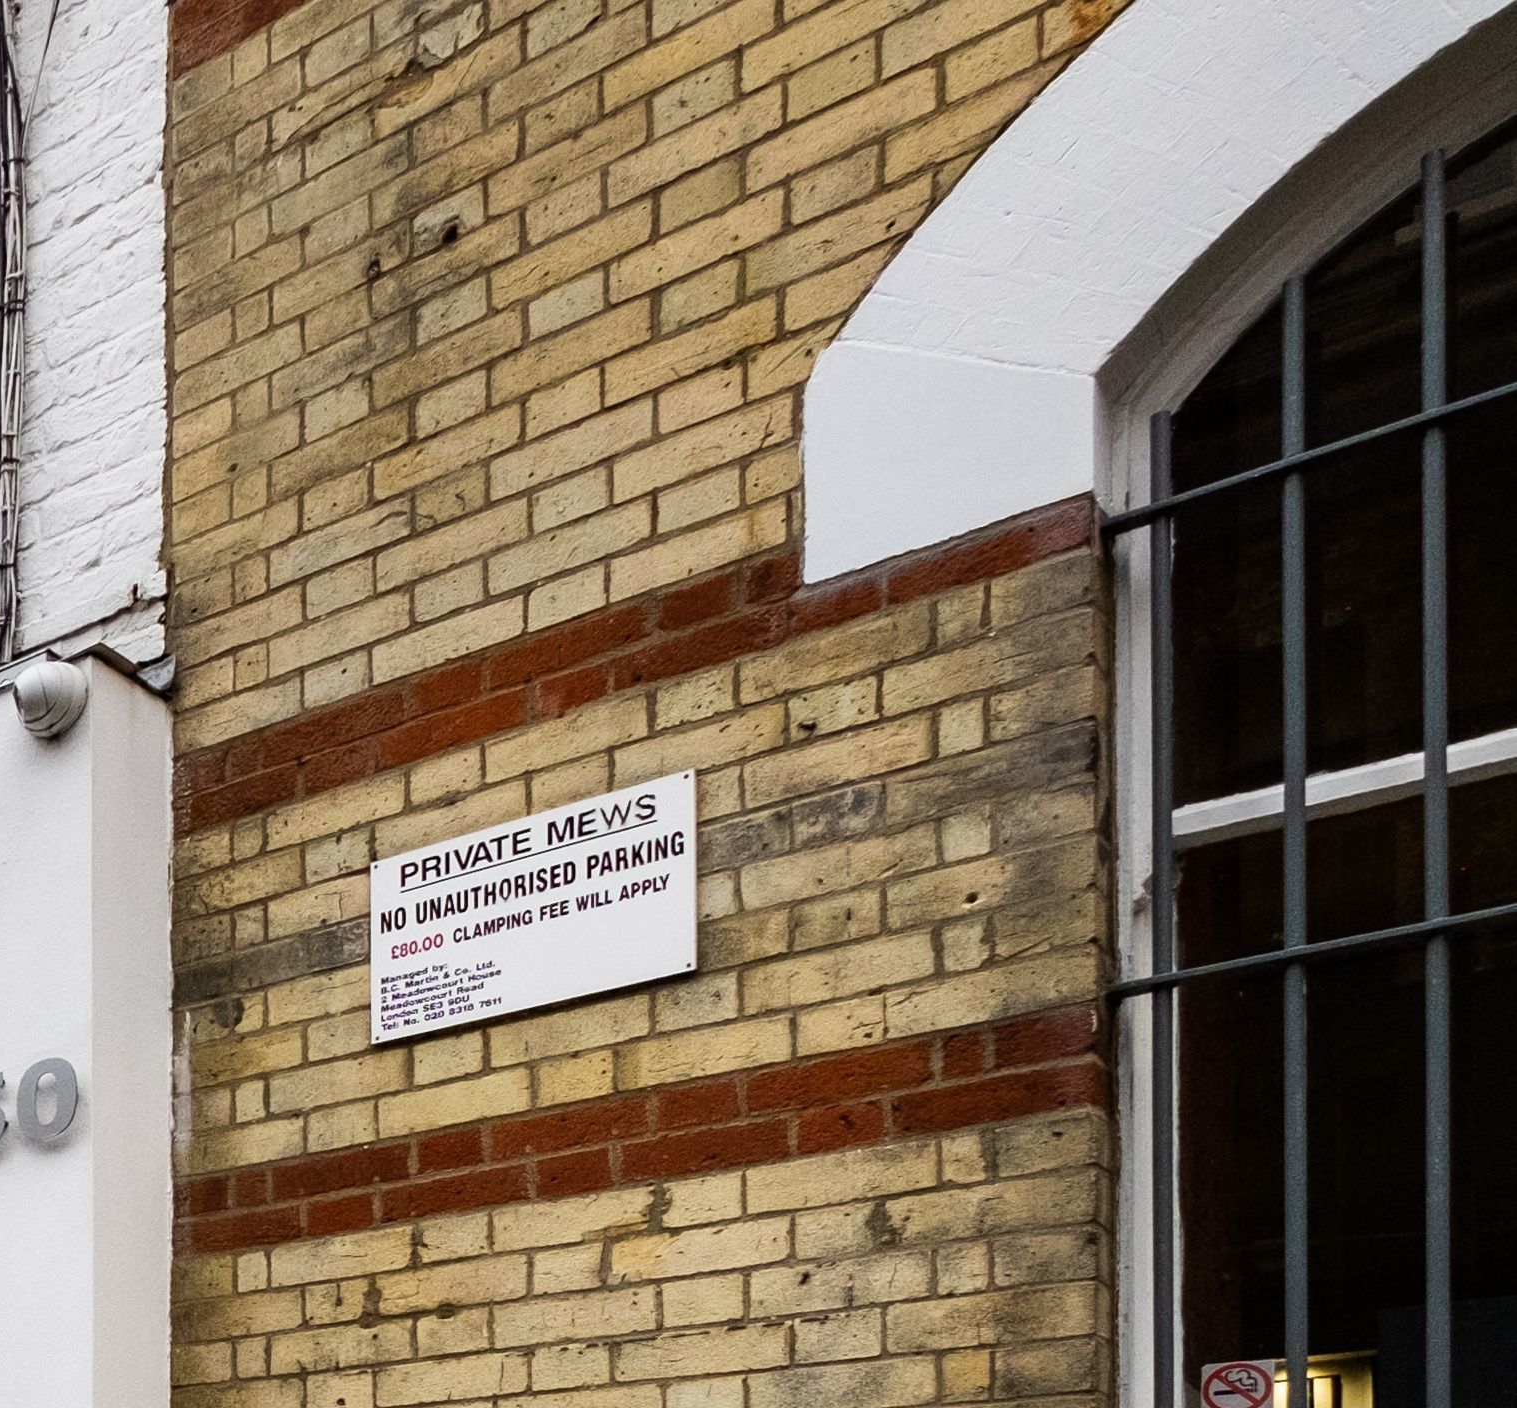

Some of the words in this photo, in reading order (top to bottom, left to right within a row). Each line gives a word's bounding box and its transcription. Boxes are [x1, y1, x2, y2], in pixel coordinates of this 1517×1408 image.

[400, 828, 533, 887] PRIVATE
[547, 794, 656, 846] MEWS
[380, 907, 407, 934] NO
[416, 861, 576, 925] UNAUTHORISED
[586, 831, 685, 880] PARKING
[390, 933, 444, 960] £80.00
[453, 909, 533, 944] CLAMPING
[539, 900, 570, 922] FEE
[575, 890, 613, 912] WILL
[619, 873, 670, 901] APPLY
[380, 967, 428, 985] Managed
[381, 996, 387, 1004] 2
[391, 978, 463, 1001] Meadowcourt
[468, 969, 502, 983] House
[405, 975, 439, 988] Martin
[442, 971, 450, 980] &
[476, 960, 496, 971] Ltd.
[380, 990, 452, 1013] Meadowcourt
[457, 982, 484, 995] Road
[380, 1009, 418, 1022] London
[423, 1001, 443, 1012] SE3
[403, 1018, 420, 1027] No.
[424, 1011, 445, 1021] 020
